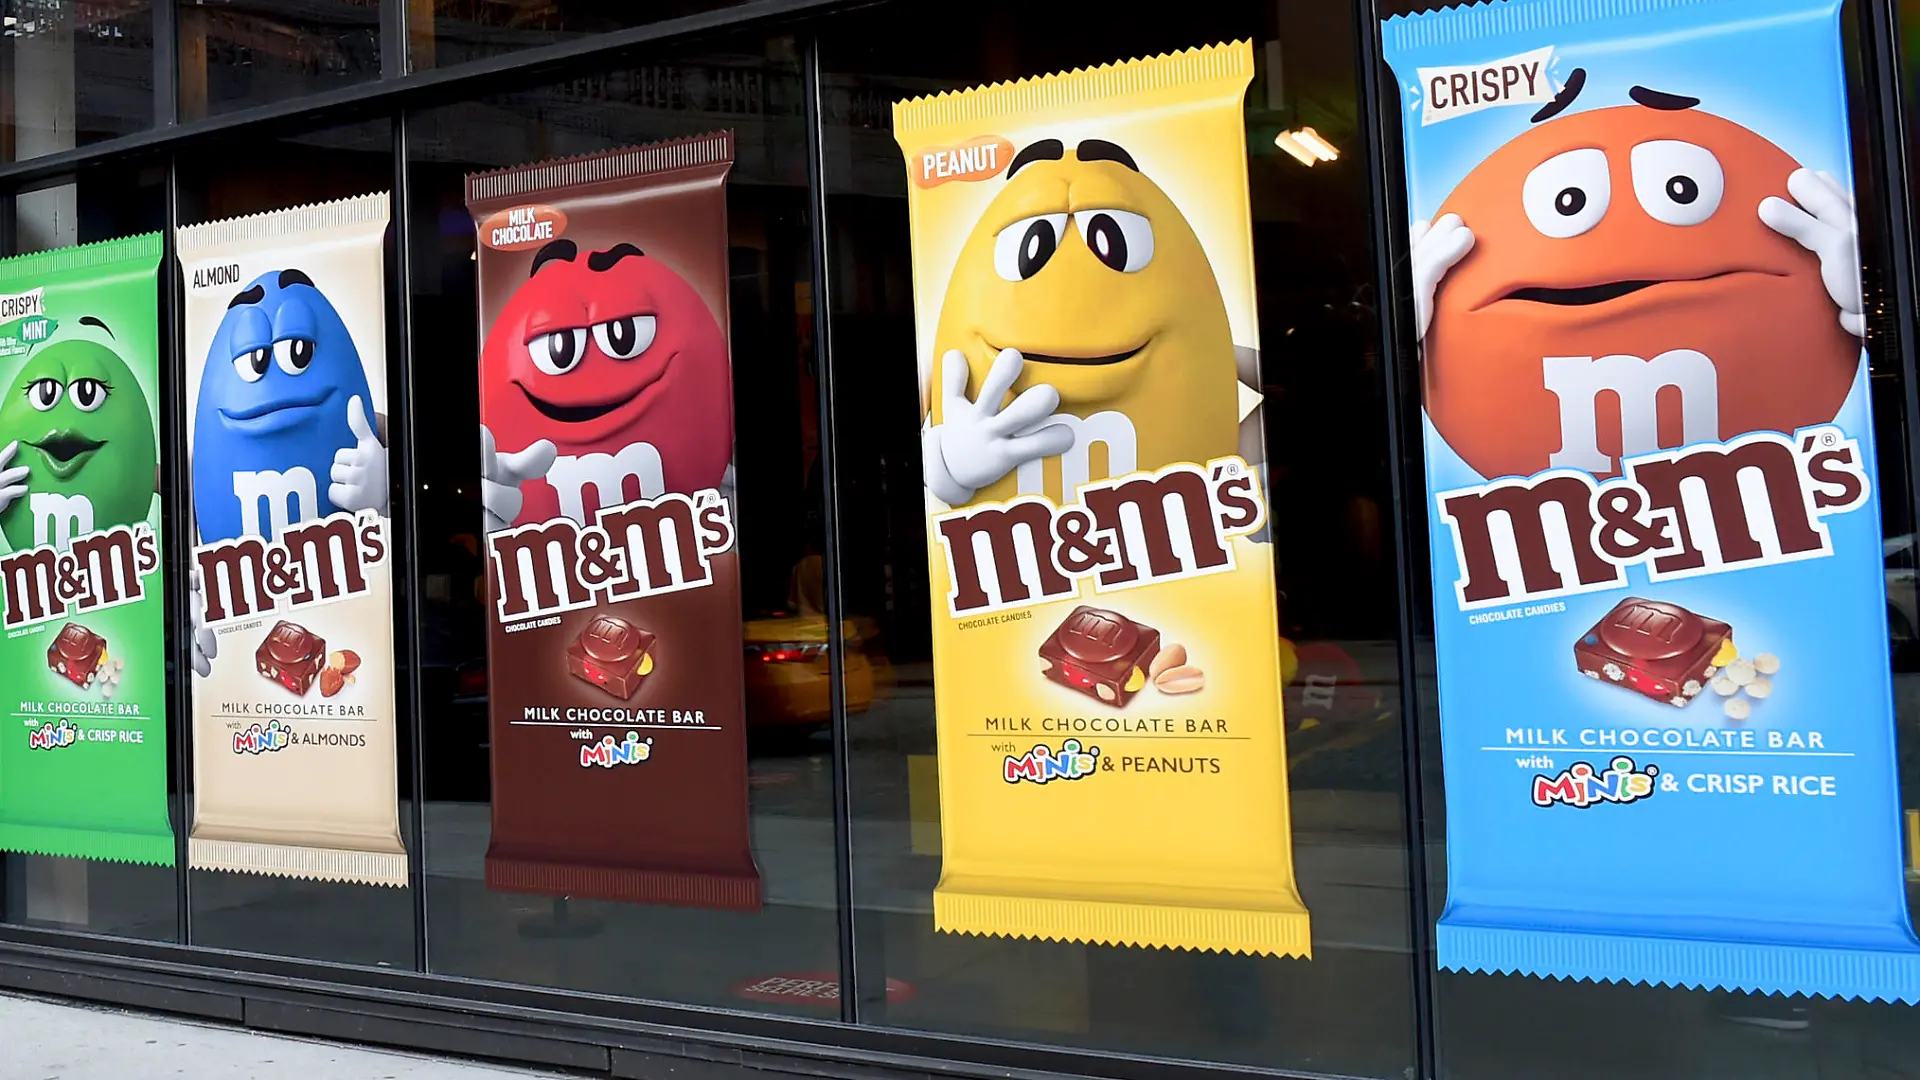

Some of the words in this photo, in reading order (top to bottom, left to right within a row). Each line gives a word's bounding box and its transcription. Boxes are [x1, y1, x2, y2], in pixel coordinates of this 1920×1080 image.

[1430, 61, 1539, 109] CRISPY
[923, 144, 998, 180] PEANUT
[508, 207, 536, 227] MILK
[492, 221, 553, 246] CHOCOLATE
[193, 264, 240, 289] ALMOND
[2, 295, 38, 317] CRISPY
[22, 320, 48, 340] MINT
[1543, 349, 1719, 472] m
[546, 442, 665, 526] m
[505, 620, 537, 633] CHOCOLATE
[537, 616, 562, 627] CANDIES
[958, 615, 999, 631] CHOCOLATE
[1000, 610, 1032, 623] CANDIES
[1469, 608, 1524, 625] CHOCOLATE
[1524, 602, 1566, 617] CANDIES
[20, 701, 44, 712] MILK
[48, 702, 113, 714] CHOCOLATE
[118, 703, 140, 715] BAR
[222, 702, 250, 714] MILK
[255, 703, 333, 716] CHOCOLATE
[339, 705, 365, 717] BAR
[524, 707, 560, 720] MILK
[566, 707, 666, 723] CHOCOLATE
[672, 711, 706, 724] BAR
[24, 719, 39, 727] with
[78, 730, 85, 741] &
[88, 729, 116, 742] CRISP
[119, 730, 143, 743] RICE
[226, 720, 242, 730] with
[291, 732, 299, 745] &
[302, 733, 366, 747] ALMONDS
[570, 728, 593, 740] with
[985, 718, 1032, 731] MILK
[1042, 718, 1175, 732] CHOCOLATE
[1186, 719, 1228, 733] BAR
[1505, 728, 1568, 745] MILK
[1580, 729, 1755, 747] CHOCOLATE
[1768, 731, 1825, 748] BAR
[991, 742, 1016, 753] with
[1101, 757, 1115, 772] &
[1122, 757, 1221, 774] PEANUTS
[1516, 755, 1554, 769] with
[1660, 774, 1679, 792] &
[1687, 774, 1764, 793] CRISP
[1773, 776, 1836, 796] RICE
